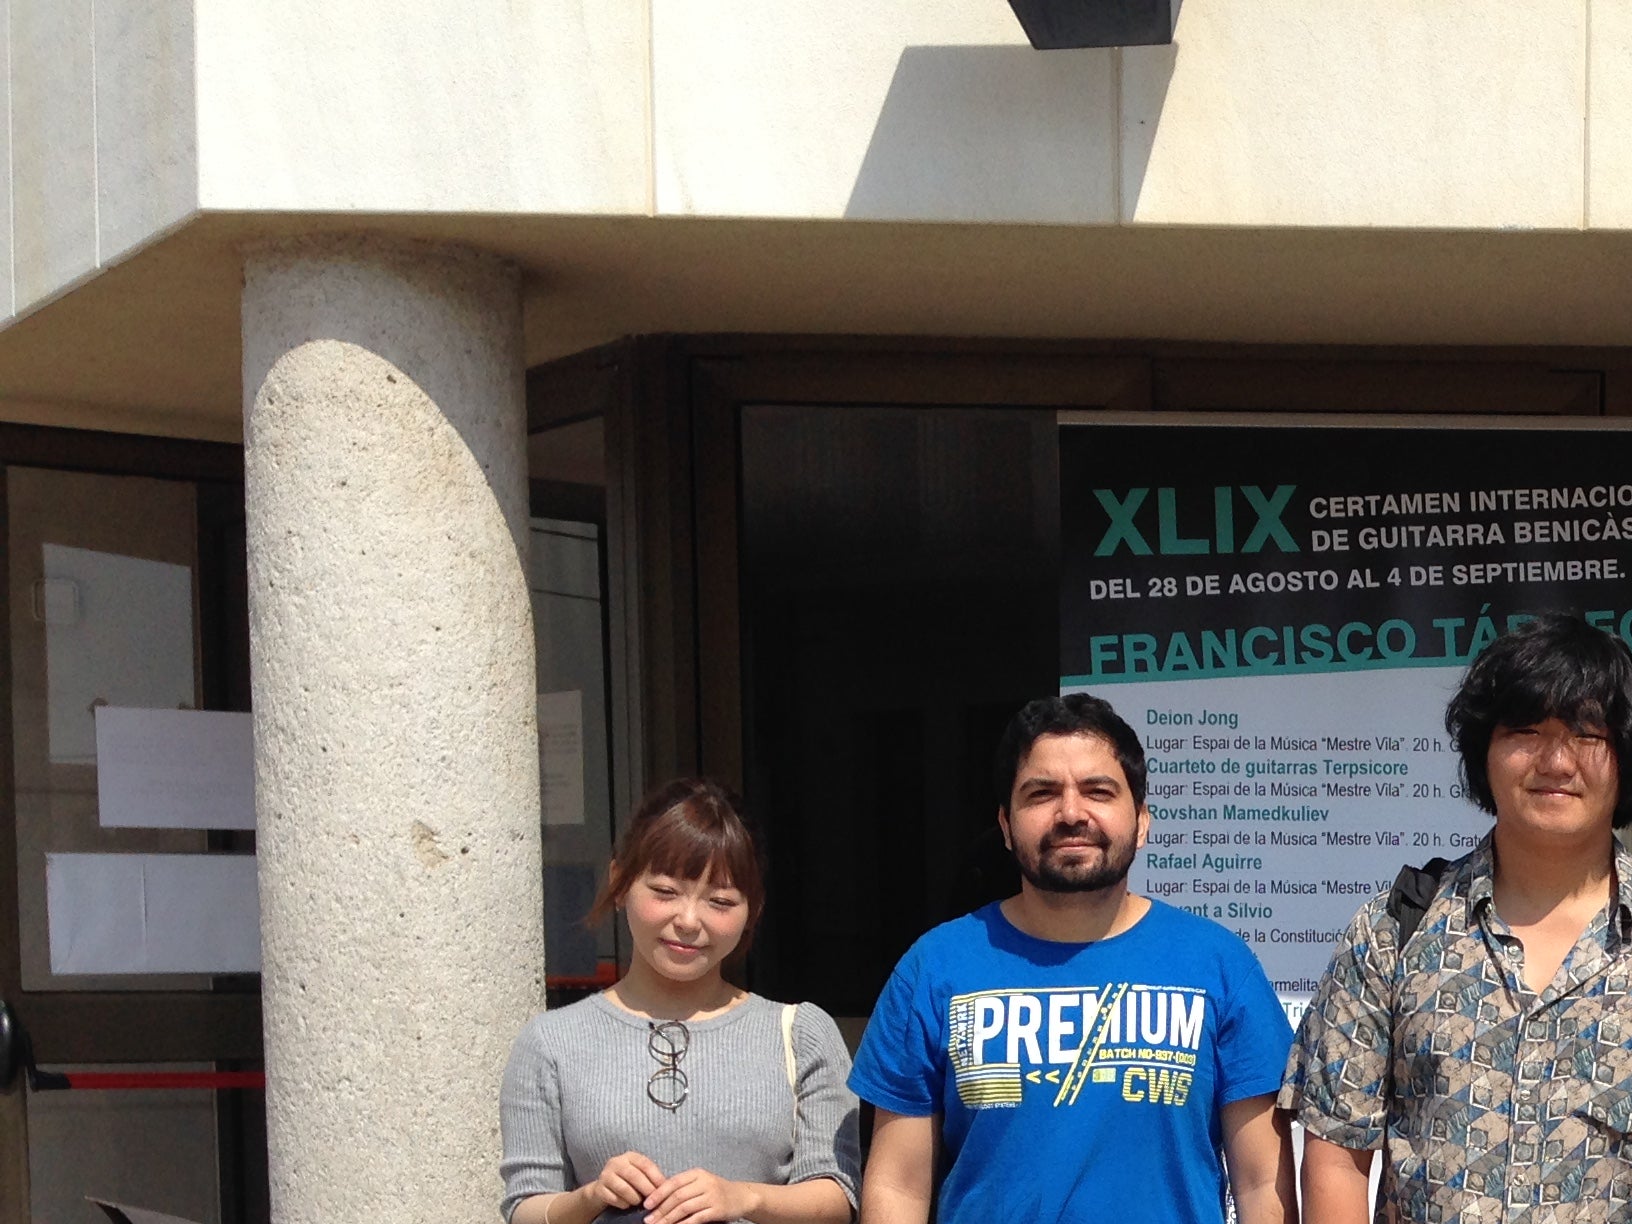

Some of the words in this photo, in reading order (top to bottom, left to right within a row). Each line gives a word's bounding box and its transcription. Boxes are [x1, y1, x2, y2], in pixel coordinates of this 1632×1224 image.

[1310, 492, 1460, 519] CERTAMEN
[1094, 486, 1300, 556] XLIX
[1312, 529, 1350, 552] DE
[1359, 523, 1505, 550] GUITARRA
[1090, 578, 1141, 600] DEL
[1148, 577, 1177, 597] 28
[1186, 575, 1221, 596] DE
[1229, 570, 1338, 594] AGOSTO
[1347, 568, 1380, 589] AL
[1387, 568, 1402, 586] 4
[1410, 566, 1444, 586] DE
[1452, 559, 1625, 585] SEPTIEMBRE.
[1089, 619, 1416, 677] FRANCISCO
[1147, 709, 1192, 725] Deion
[1198, 710, 1238, 729] Jong
[1193, 736, 1229, 752] Espai
[1234, 736, 1250, 749] de
[1255, 736, 1266, 750] la
[1271, 736, 1317, 751] Música
[1413, 738, 1429, 752] 20
[1147, 758, 1216, 774] Cuarteto
[1221, 758, 1240, 773] de
[1246, 759, 1317, 778] guitarras
[1323, 760, 1408, 778] Terpsicore
[1193, 781, 1229, 799] Espai
[1234, 782, 1250, 796] de
[1255, 782, 1266, 796] la
[1271, 782, 1317, 797] Música
[1413, 784, 1429, 798] 20
[1147, 804, 1217, 820] Rovshan
[1223, 805, 1329, 821] Mamedkuliev
[1193, 830, 1229, 847] Espai
[1234, 831, 1250, 845] de
[1255, 831, 1266, 845] la
[1271, 831, 1317, 845] Música
[1413, 832, 1429, 846] 20
[1147, 853, 1196, 869] Rafael
[1202, 853, 1262, 873] Aguirre
[1193, 879, 1229, 896] Espai
[1234, 880, 1250, 893] de
[1255, 880, 1266, 894] la
[1271, 880, 1317, 894] Música
[1213, 907, 1222, 918] a
[1228, 902, 1272, 918] Silvio
[1255, 929, 1265, 942] la
[974, 992, 1205, 1065] PREMIUM
[1122, 1067, 1193, 1106] CWS
